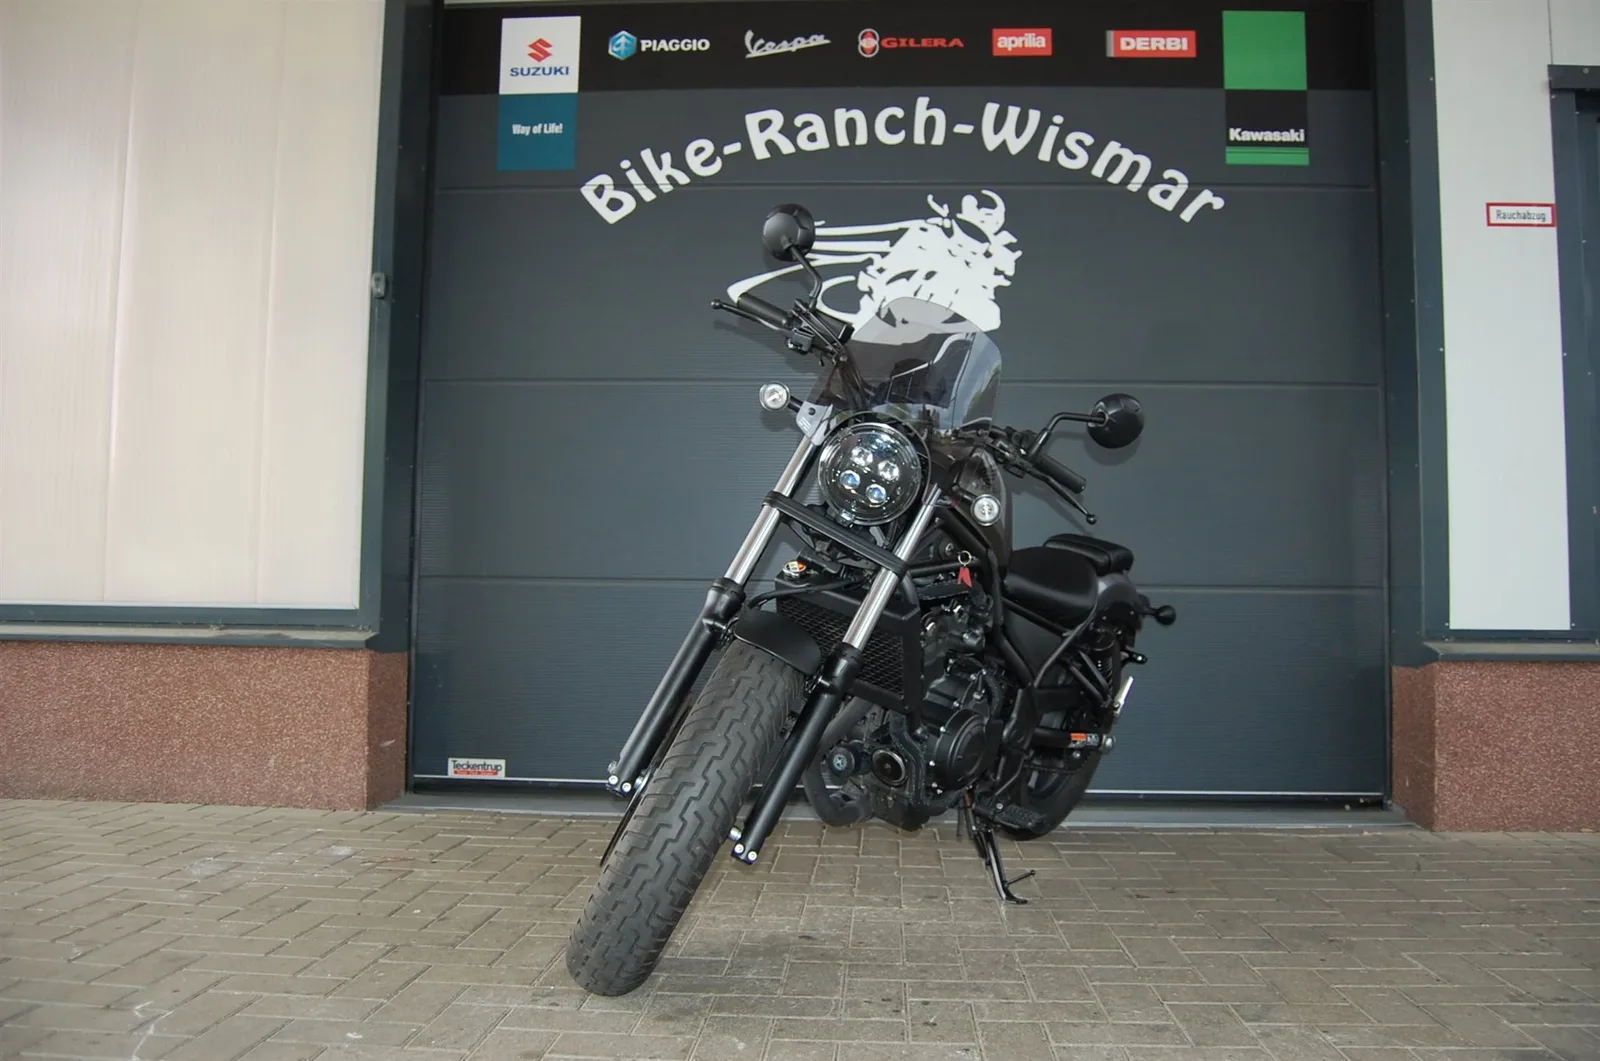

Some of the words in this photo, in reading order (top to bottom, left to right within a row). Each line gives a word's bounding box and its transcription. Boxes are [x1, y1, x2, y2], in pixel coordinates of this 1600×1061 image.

[640, 38, 711, 52] PIAGGIO
[745, 29, 831, 58] Vespa
[881, 37, 965, 48] GILERA
[997, 33, 1046, 50] aprilia
[1120, 37, 1188, 51] DERBI
[510, 66, 569, 77] SUZUKI
[512, 123, 530, 136] Way
[532, 123, 542, 135] of
[544, 123, 563, 134] Life!
[1229, 127, 1306, 143] Kawasaki
[580, 96, 1225, 224] Bike-Ranch-Wismar
[1496, 209, 1546, 222] Rauchabzug
[451, 760, 503, 771] Teckentrup
